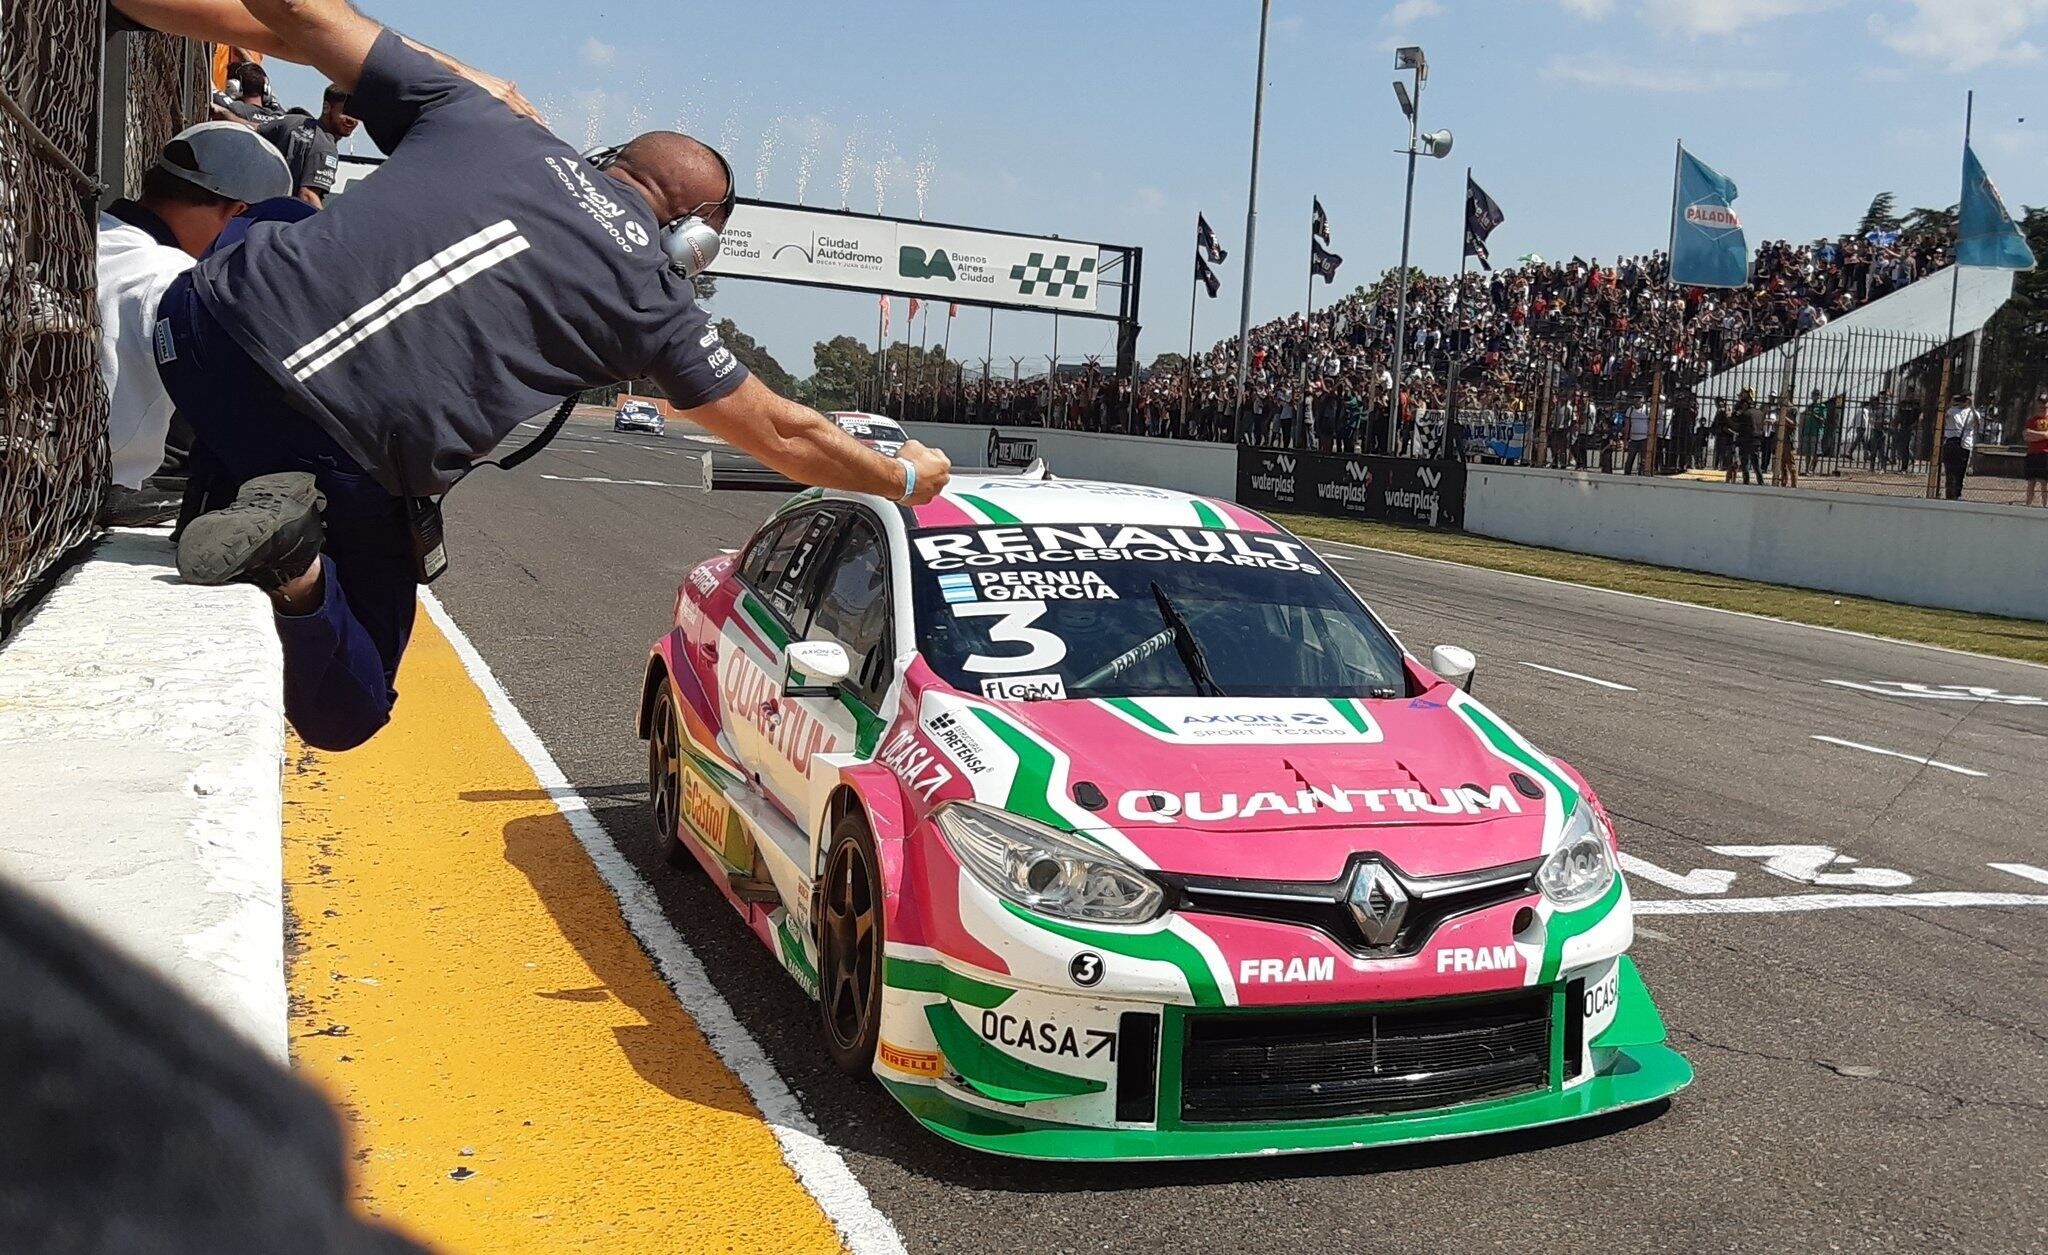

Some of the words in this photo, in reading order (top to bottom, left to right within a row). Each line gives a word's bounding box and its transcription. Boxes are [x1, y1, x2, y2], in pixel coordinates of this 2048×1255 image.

[544, 156, 581, 199] SPORT
[561, 156, 626, 217] AXION
[720, 228, 752, 238] uenos
[720, 236, 749, 248] Aires
[817, 236, 859, 250] Ciudad
[722, 246, 761, 259] Ciudad
[817, 247, 883, 264] Autódromo
[951, 252, 987, 264] Buenos
[957, 263, 984, 273] Aires
[960, 272, 995, 284] Ciudad
[1251, 473, 1295, 498] waterplast
[1317, 481, 1366, 507] waterplast
[913, 526, 1303, 562] RENAULT
[927, 547, 1321, 575] CONCESIONARIOS
[977, 570, 1106, 586] PERNIA
[951, 600, 1067, 673] 3
[1183, 714, 1284, 724] AXION
[1193, 728, 1256, 738] SPORT
[881, 729, 935, 787] OCASA
[943, 730, 986, 775] PRETENSA
[691, 780, 726, 848] Castrol
[1116, 784, 1523, 825] QUANTIUM
[1075, 956, 1100, 982] 3
[1239, 956, 1336, 985] FRAM
[1436, 946, 1517, 973] FRAM
[981, 1009, 1080, 1058] OCASA
[880, 1041, 938, 1071] PIRELLI
